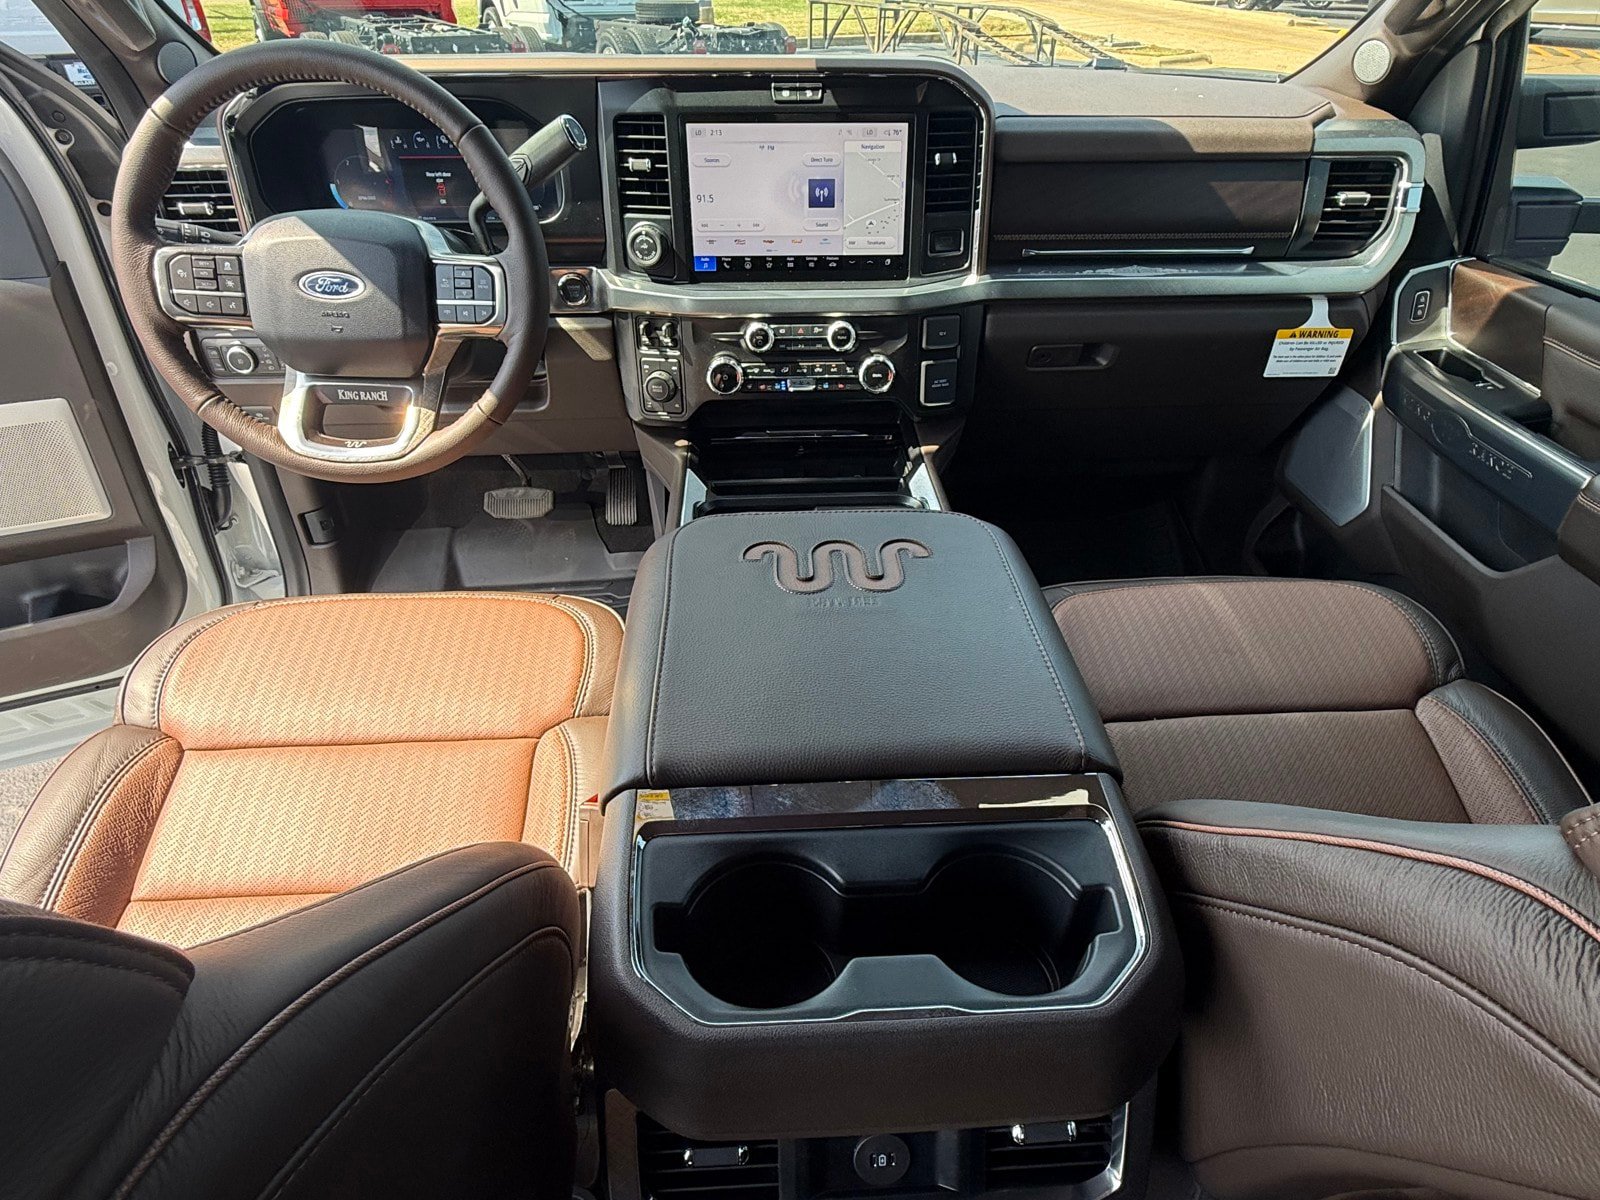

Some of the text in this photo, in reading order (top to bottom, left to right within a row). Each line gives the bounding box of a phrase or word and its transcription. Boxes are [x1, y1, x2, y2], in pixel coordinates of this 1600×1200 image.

[696, 194, 714, 203] 91.5
[315, 276, 349, 293] Ford
[1299, 330, 1339, 338] WARNING
[337, 389, 389, 401] KING RANCH
